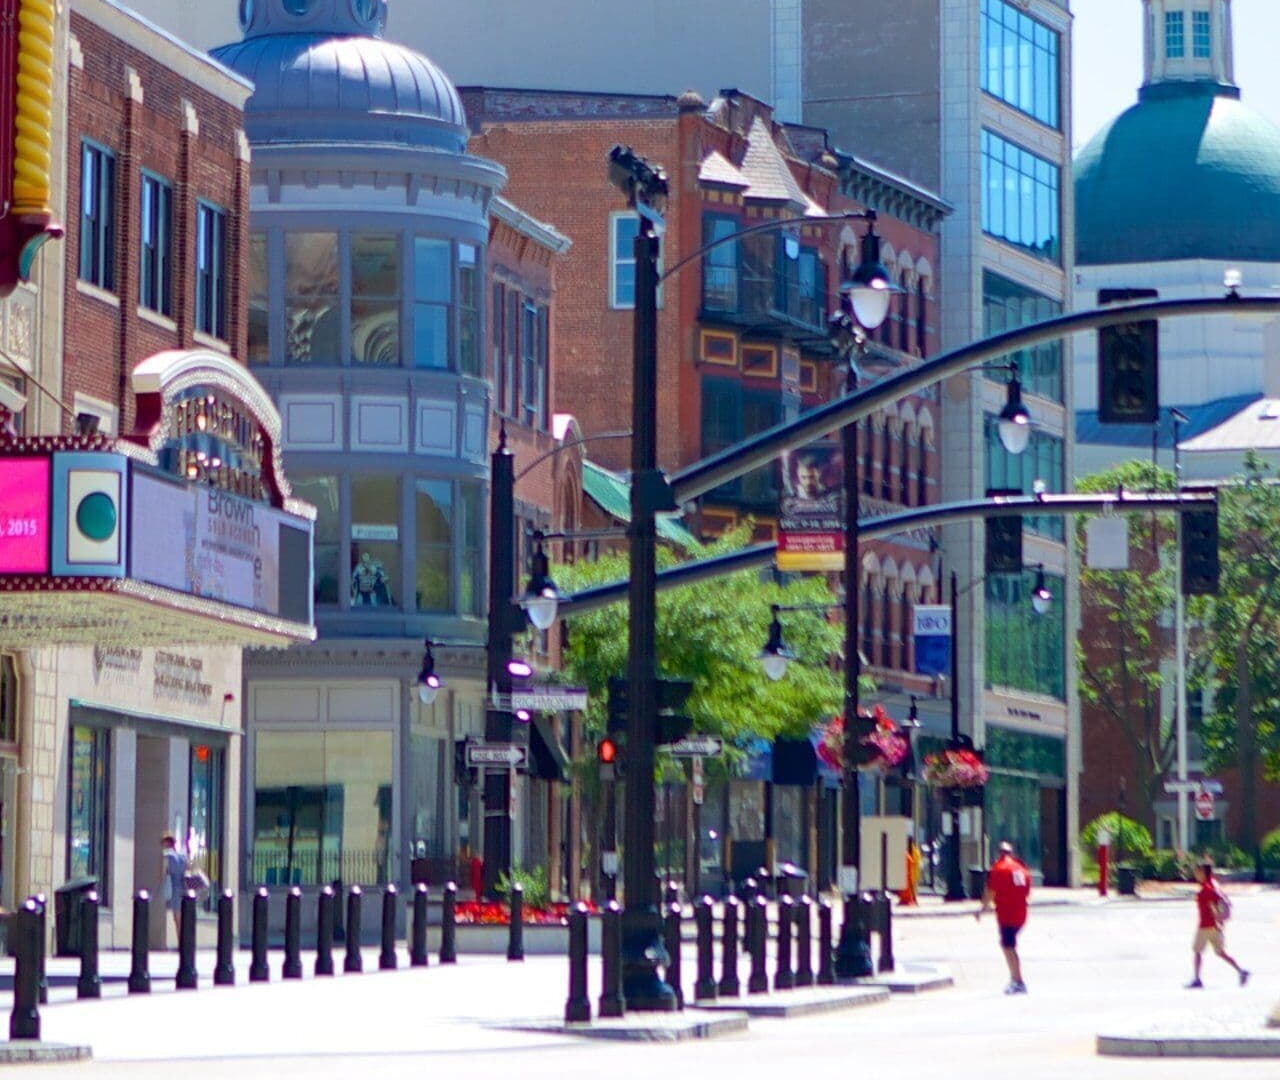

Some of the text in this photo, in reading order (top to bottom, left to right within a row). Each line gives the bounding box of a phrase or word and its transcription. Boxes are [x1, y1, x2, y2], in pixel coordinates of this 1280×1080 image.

[6, 519, 37, 537] 2015
[514, 695, 574, 709] RICHMOND
[473, 752, 509, 761] ONE WAY
